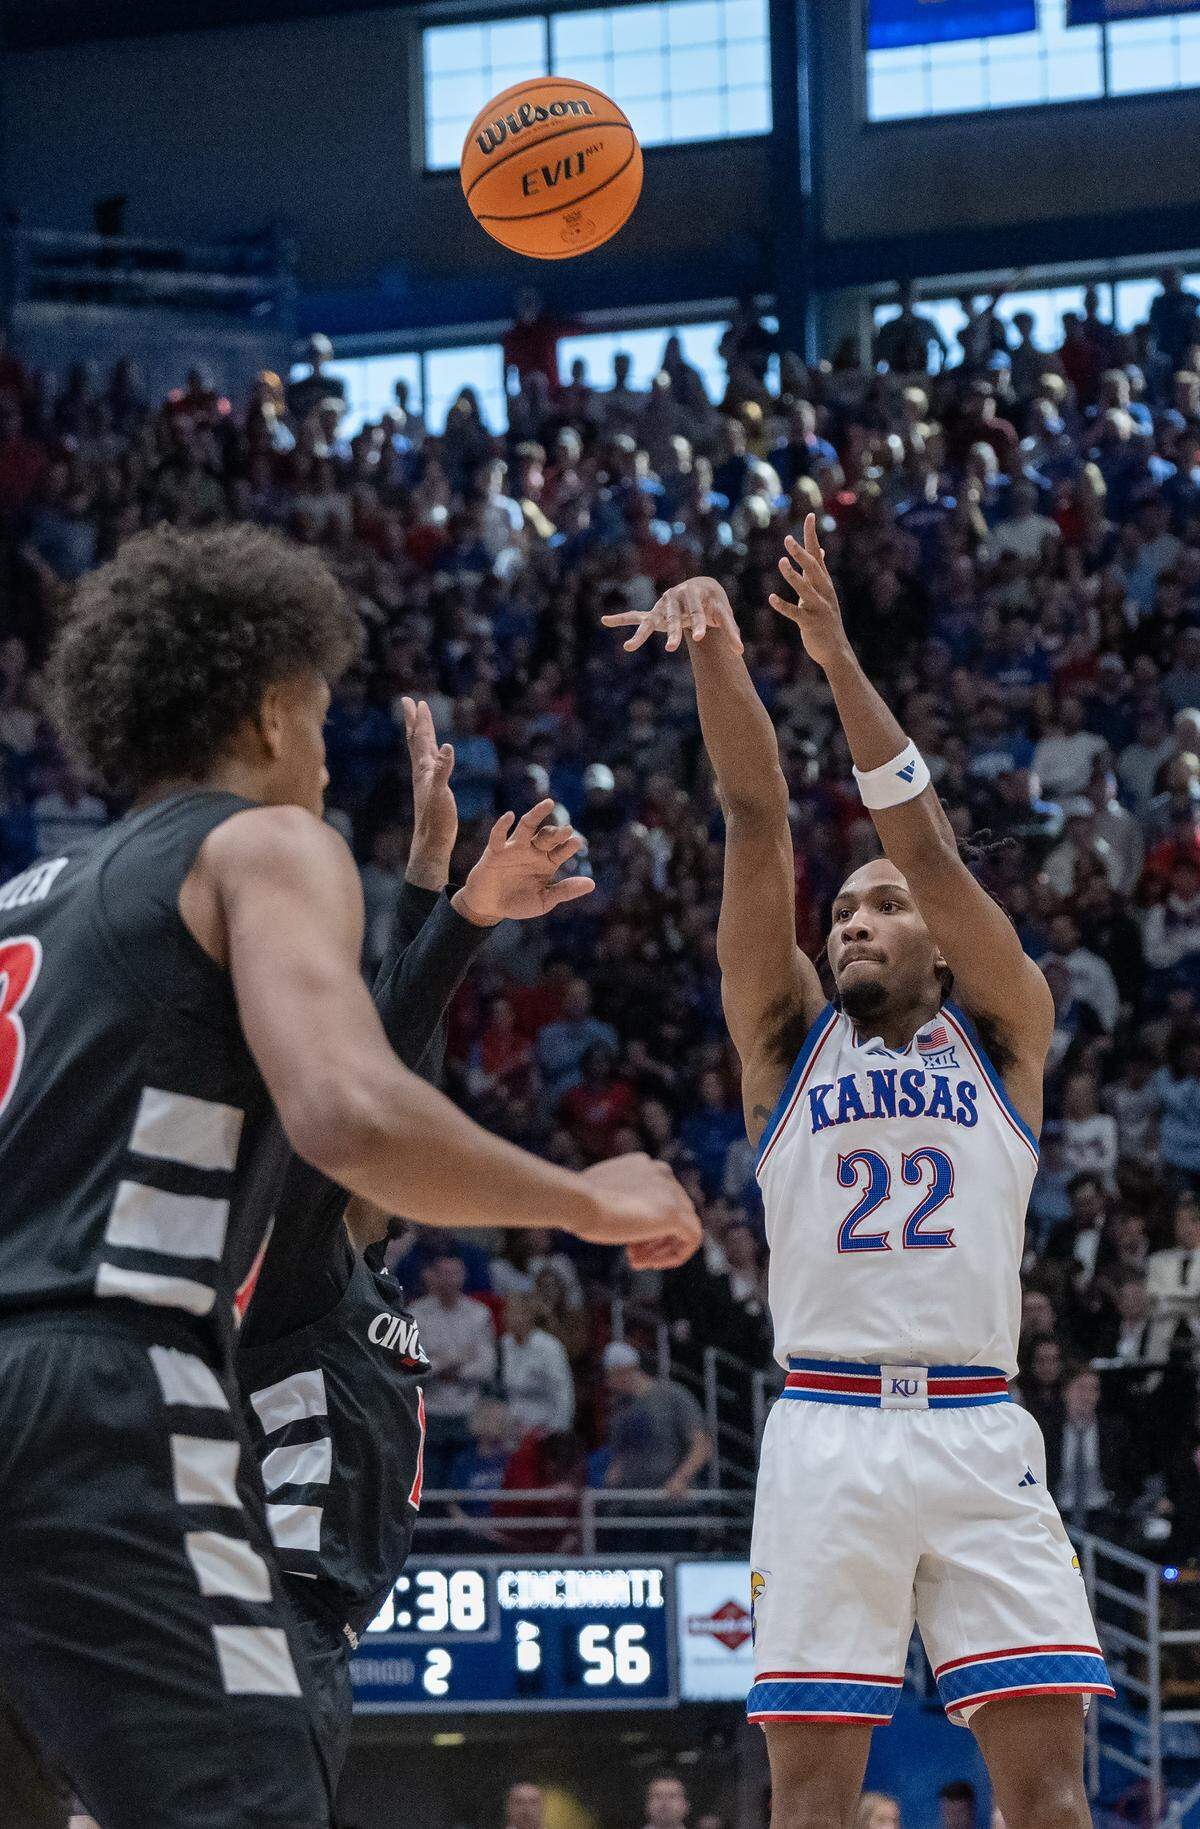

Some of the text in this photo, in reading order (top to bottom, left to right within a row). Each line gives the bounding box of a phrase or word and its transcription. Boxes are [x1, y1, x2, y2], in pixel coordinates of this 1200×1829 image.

[476, 100, 593, 155] Wilson
[807, 1068, 979, 1135] KANSAS
[836, 1146, 957, 1254] 22
[891, 1378, 919, 1398] KU
[497, 1570, 664, 1609] CINCINNATI
[423, 1648, 452, 1695] 2
[579, 1624, 651, 1685] 56
